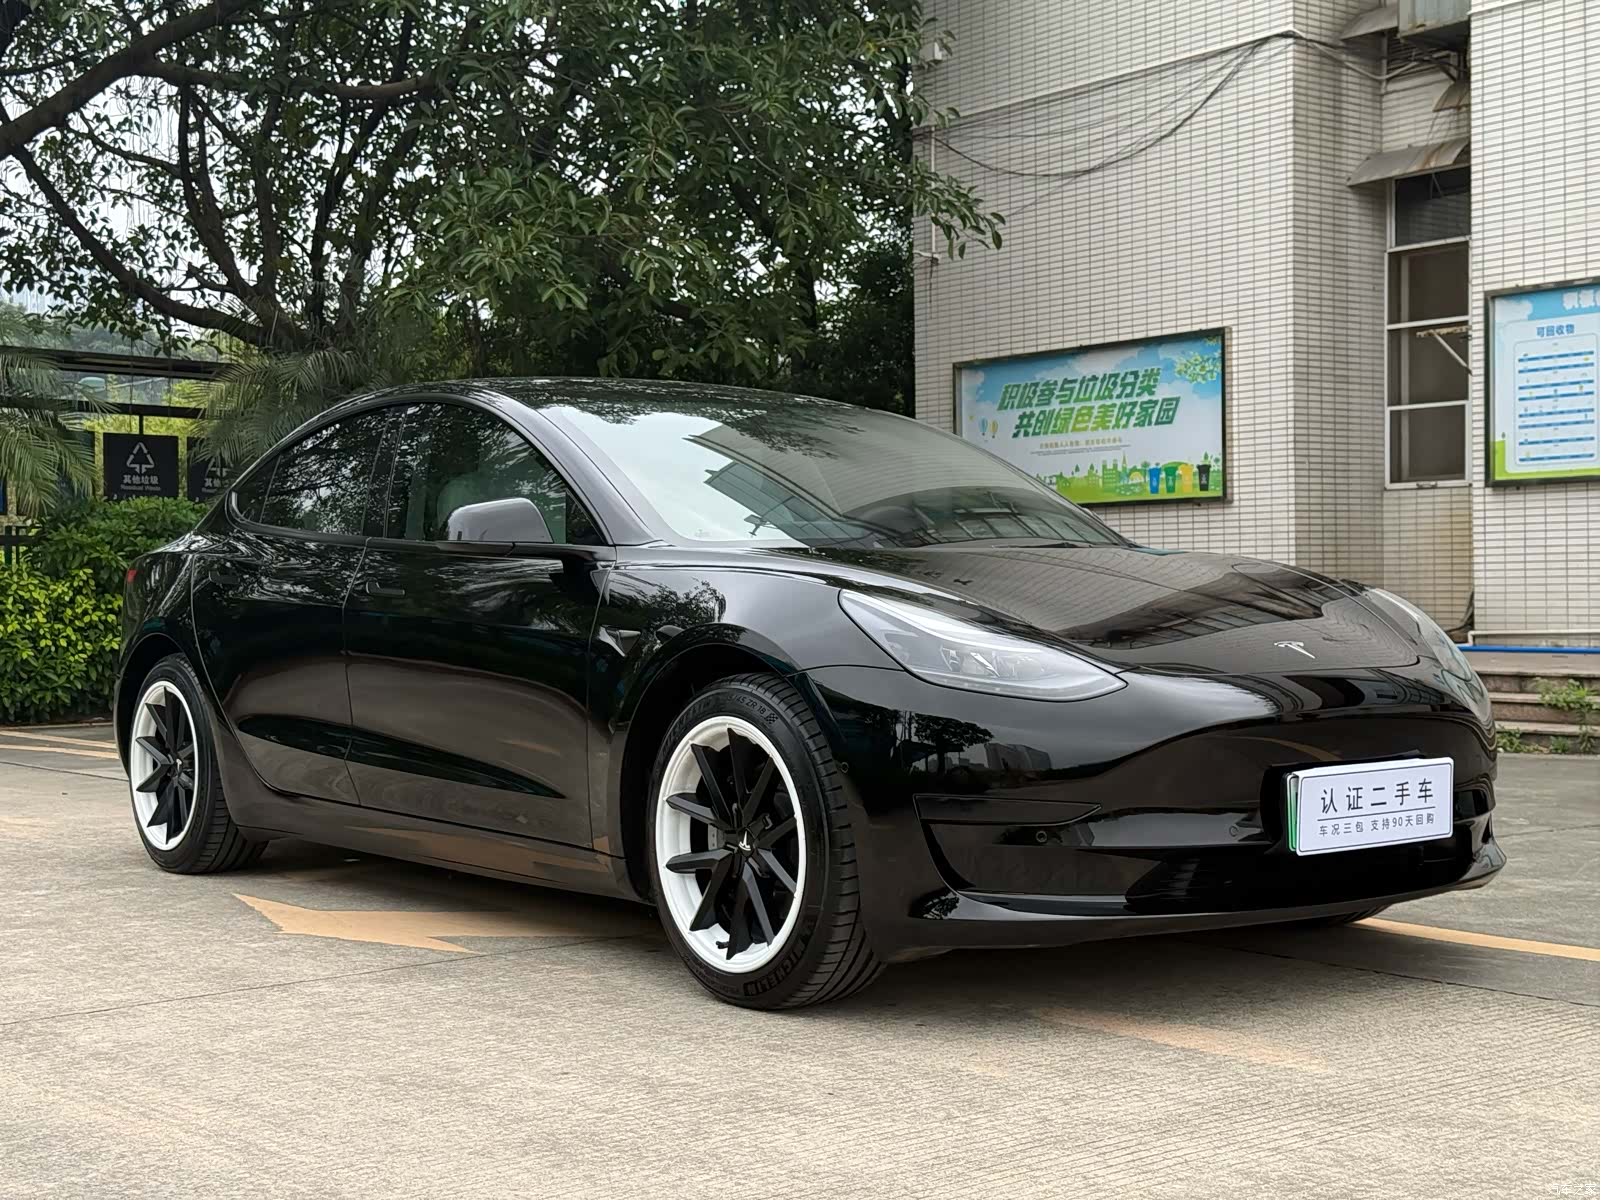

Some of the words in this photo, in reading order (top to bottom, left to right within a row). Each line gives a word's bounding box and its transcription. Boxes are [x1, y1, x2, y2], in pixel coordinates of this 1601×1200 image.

[1536, 324, 1575, 338] 可回收物
[997, 367, 1161, 411] 积极参与垃圾分类
[1012, 396, 1181, 438] 共创绿色美好家园
[123, 474, 159, 485] 其他垃圾
[758, 705, 767, 715] 18
[1320, 778, 1434, 814] 认证二手车
[1319, 821, 1364, 837] 车况三包
[1370, 812, 1435, 832] 支持90天回购
